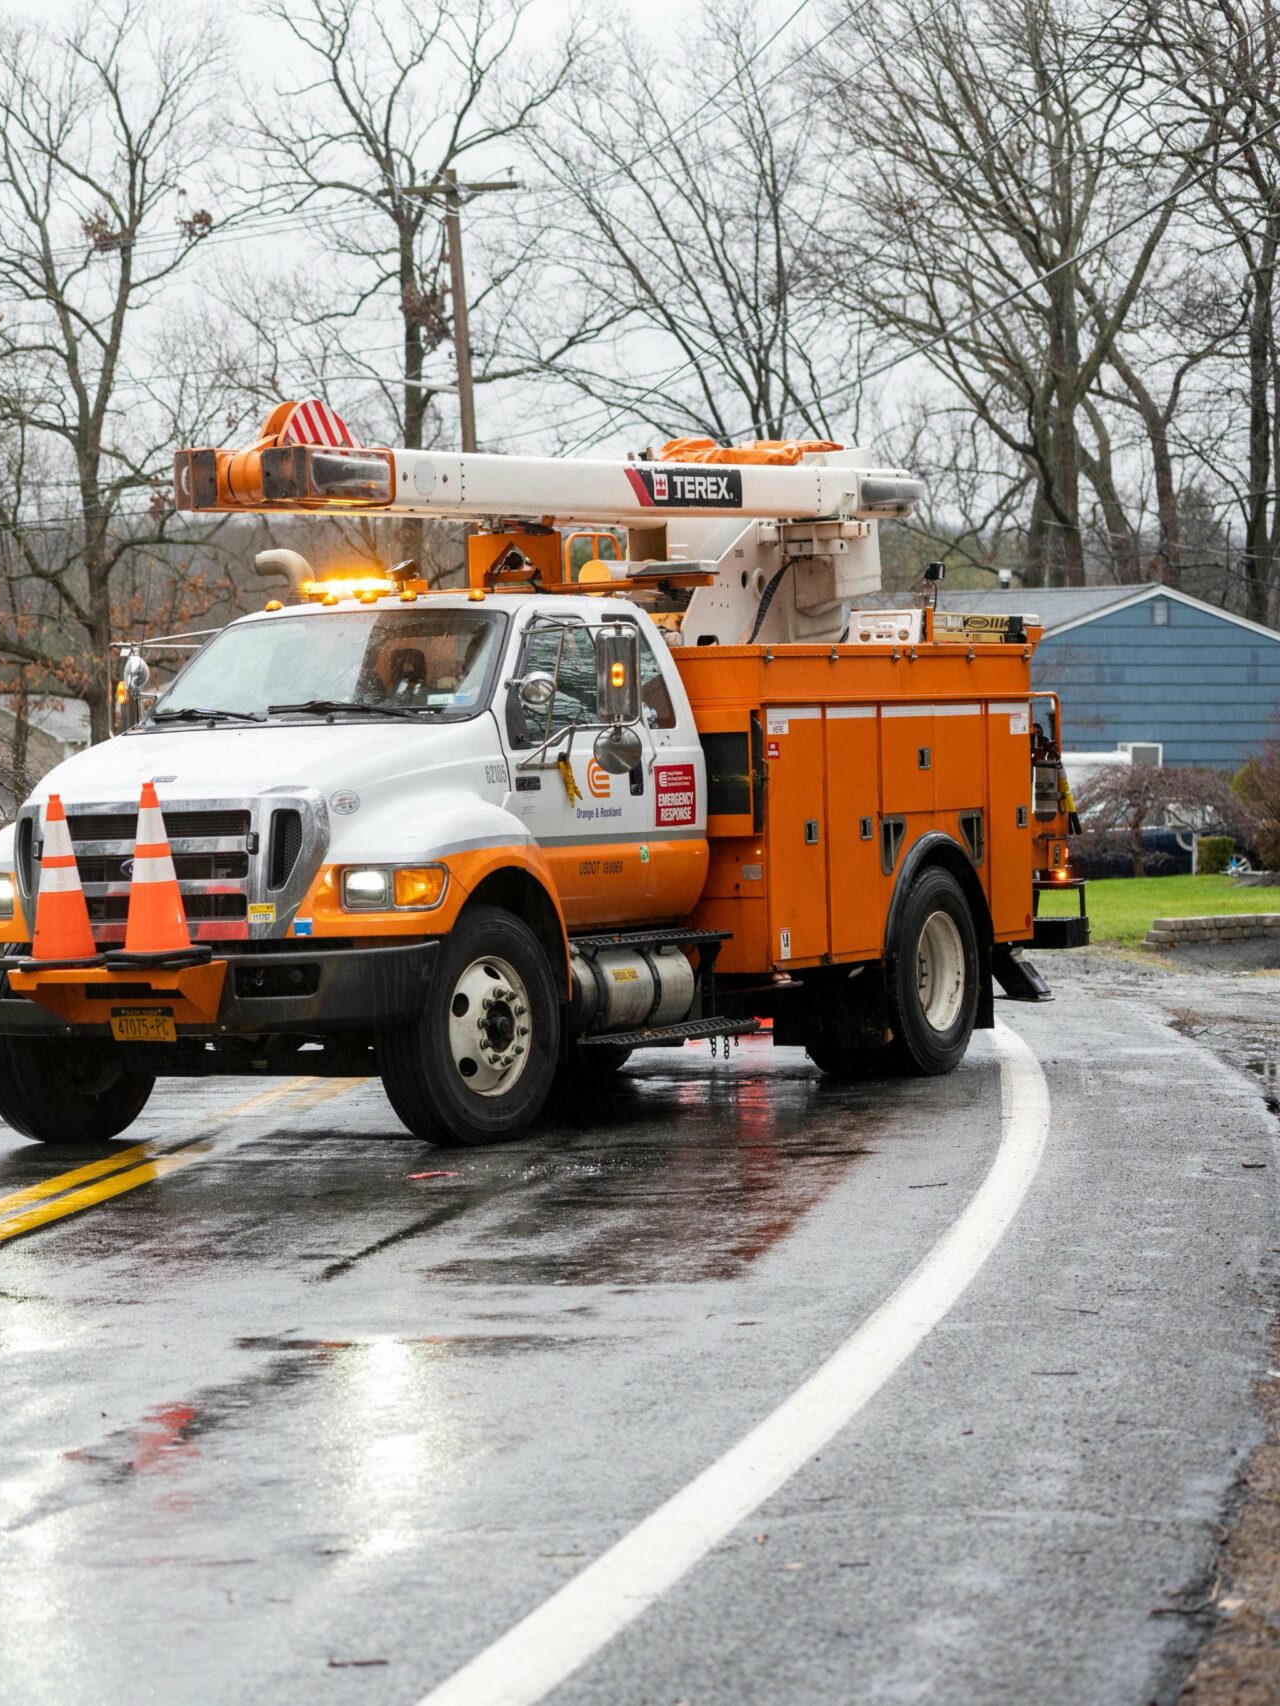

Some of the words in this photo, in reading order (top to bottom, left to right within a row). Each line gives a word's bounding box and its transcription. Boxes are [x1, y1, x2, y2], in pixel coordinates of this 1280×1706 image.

[485, 764, 507, 784] 62105
[658, 792, 694, 806] EMERGENCY
[576, 808, 594, 821] Orange
[600, 806, 622, 818] Rockland
[660, 807, 692, 822] RESPONSE
[579, 861, 601, 874] USDOT
